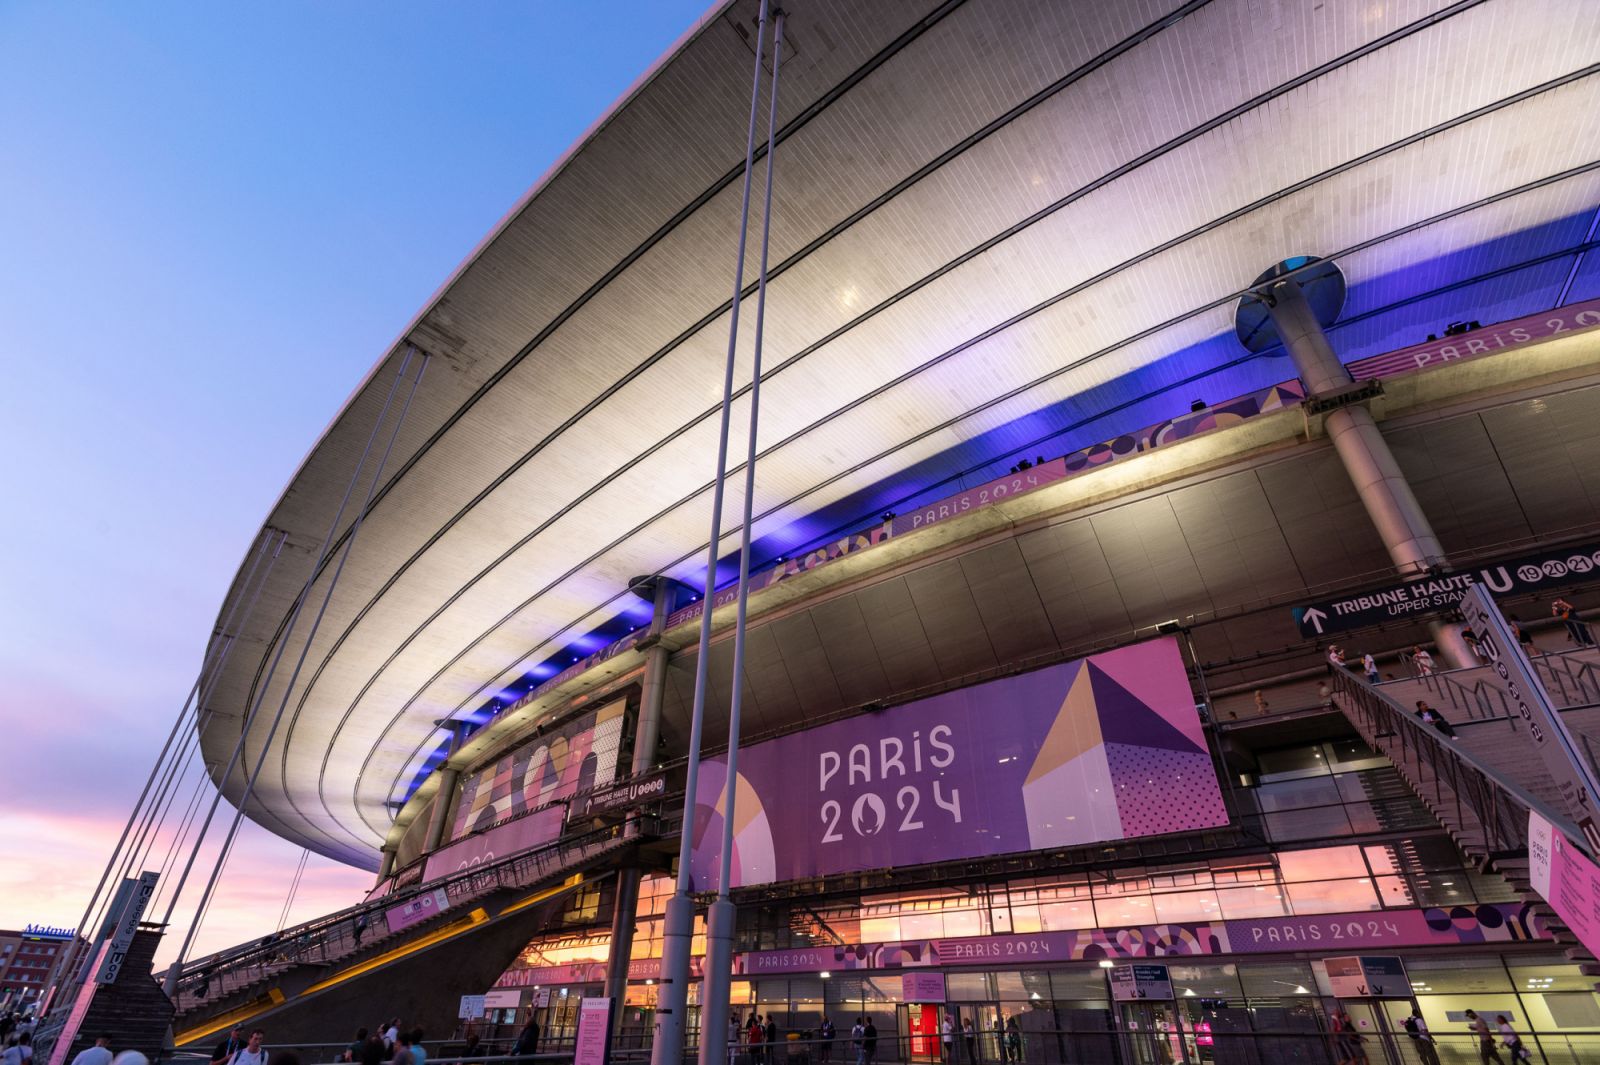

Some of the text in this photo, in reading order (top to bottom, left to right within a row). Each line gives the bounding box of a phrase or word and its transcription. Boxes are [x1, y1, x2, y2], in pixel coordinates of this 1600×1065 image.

[979, 475, 1038, 504] 2024
[1331, 587, 1409, 616] TRIBUNE
[1411, 574, 1474, 599] HAUTE
[1480, 566, 1514, 592] U
[1518, 567, 1540, 581] 19
[1543, 562, 1566, 576] 20
[1569, 557, 1591, 571] 21
[1387, 590, 1469, 616] UPPER STAN
[1482, 634, 1498, 661] U
[630, 784, 638, 800] U
[820, 780, 962, 844] 2024
[25, 923, 76, 936] Matmut
[1330, 920, 1400, 939] 2024
[792, 953, 822, 966] 2024
[955, 940, 1050, 957] PARIS 2024
